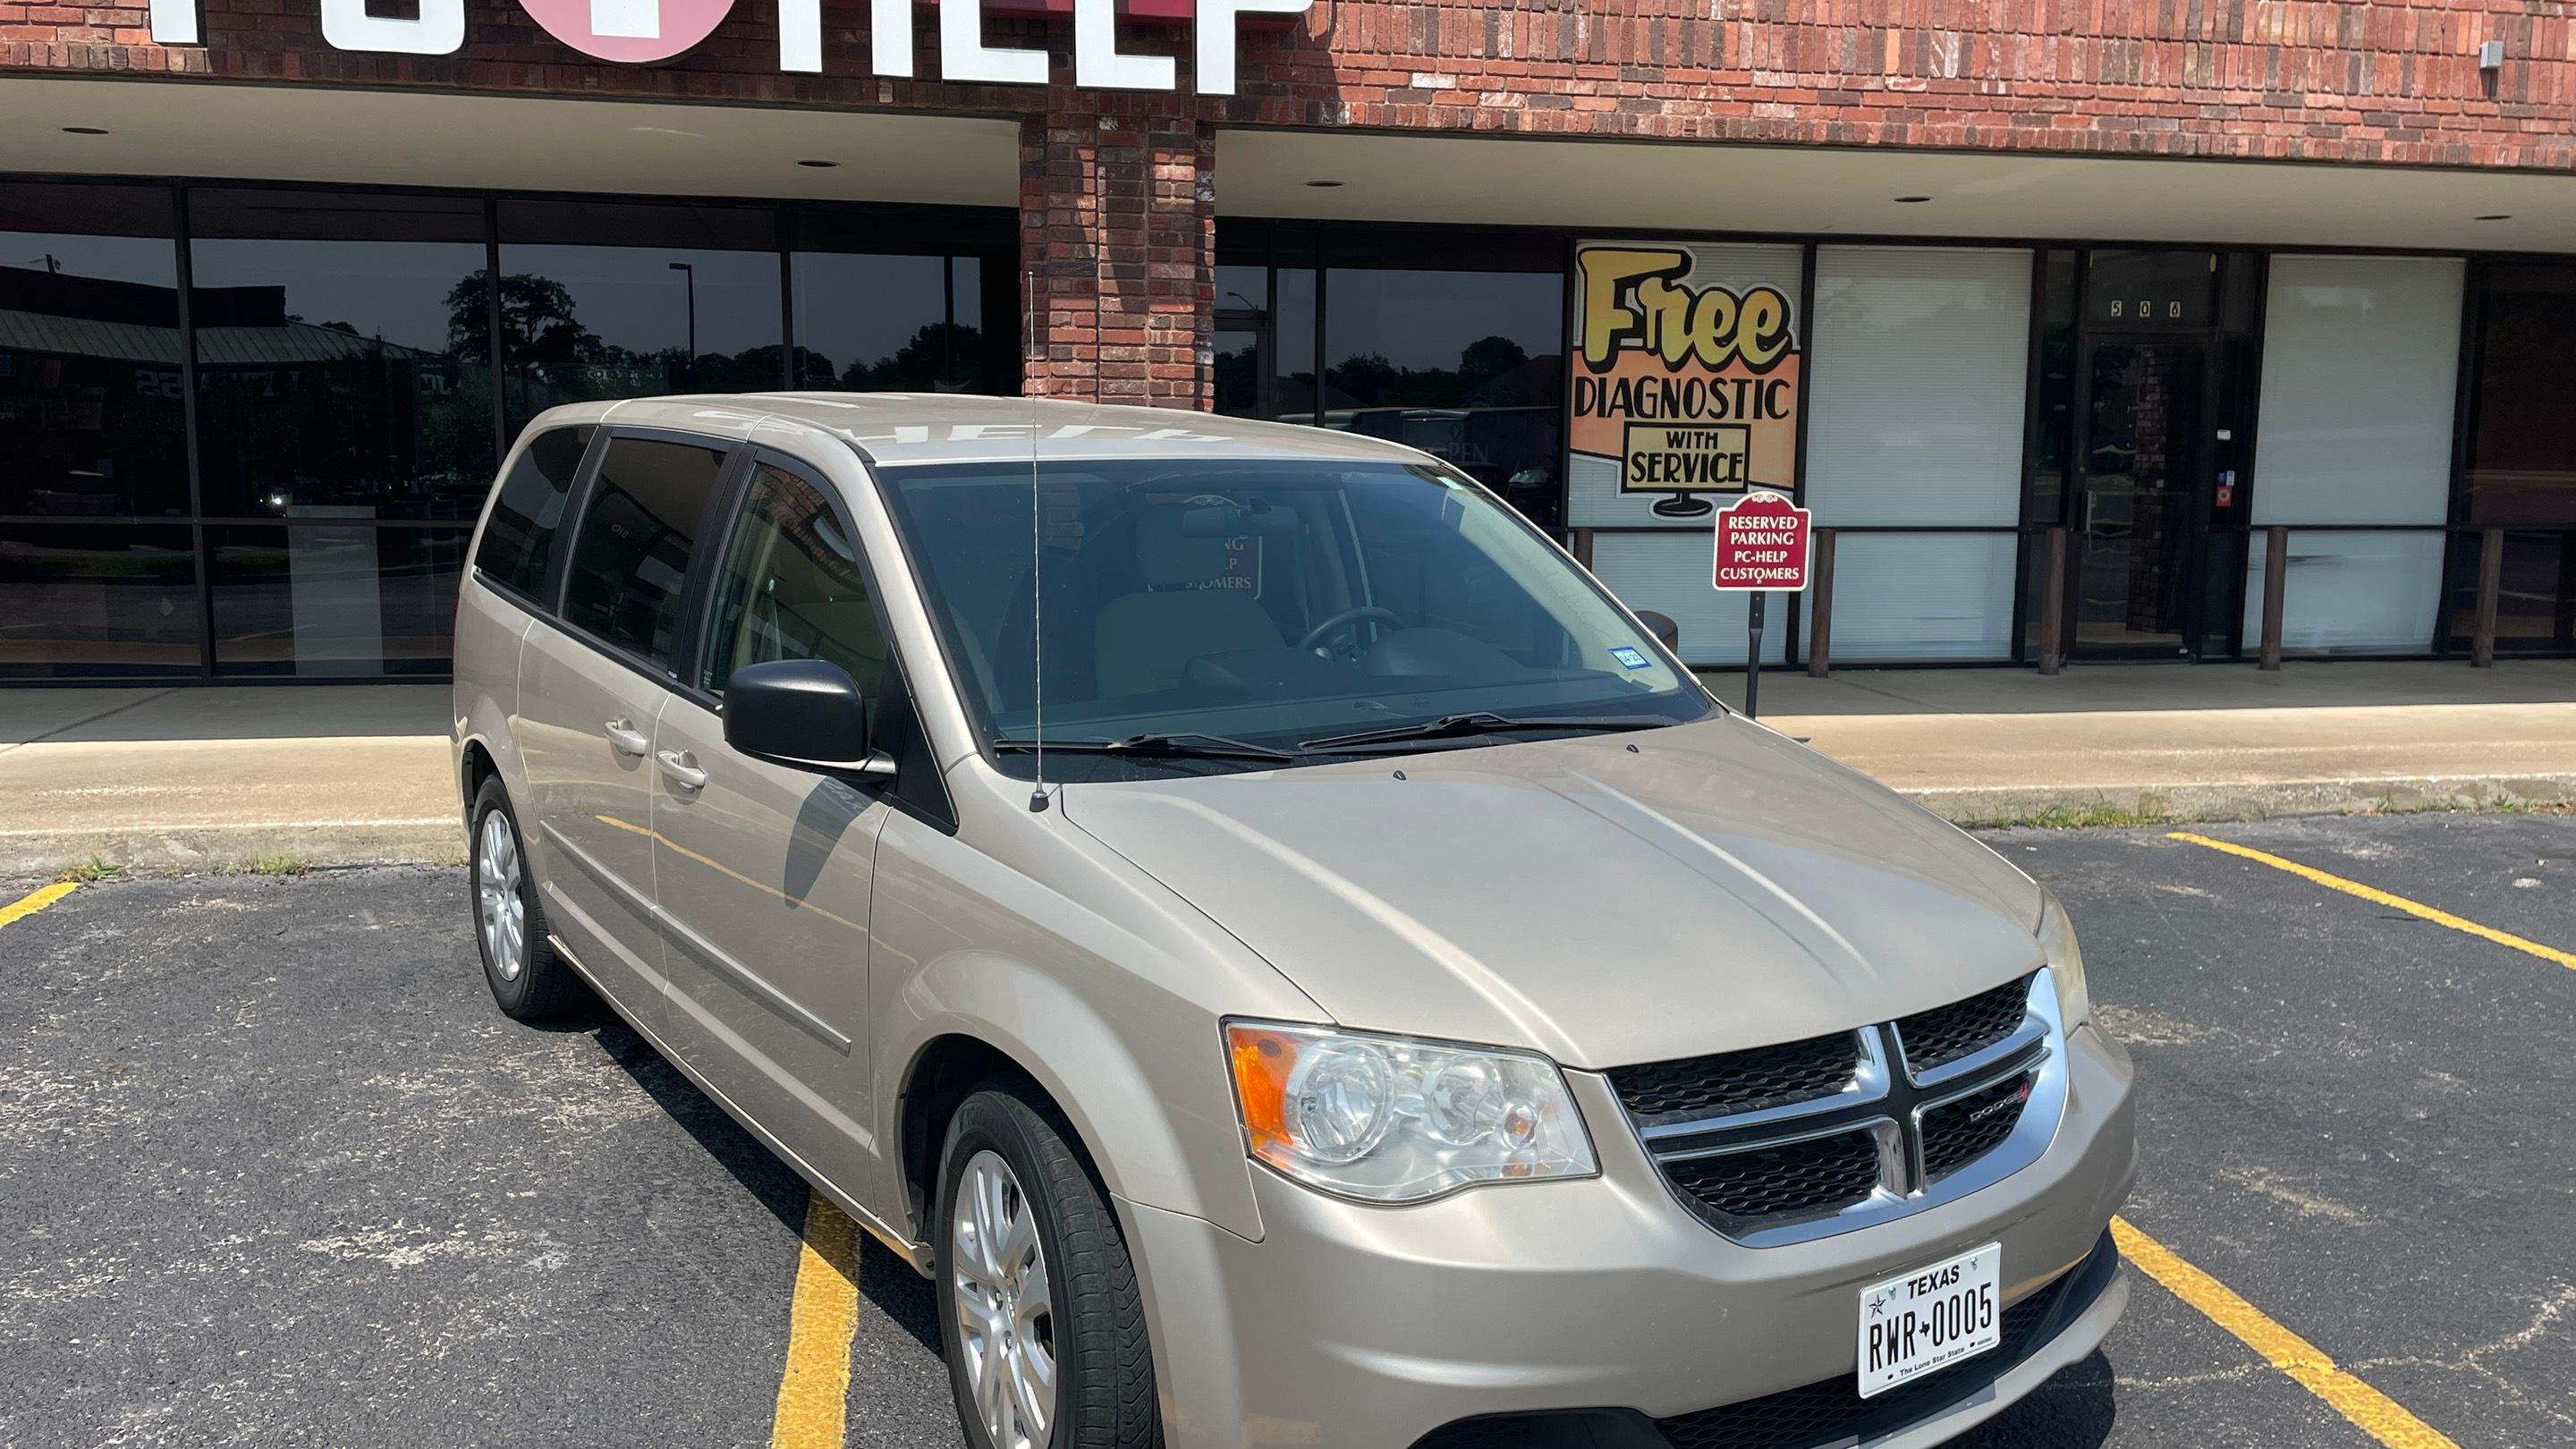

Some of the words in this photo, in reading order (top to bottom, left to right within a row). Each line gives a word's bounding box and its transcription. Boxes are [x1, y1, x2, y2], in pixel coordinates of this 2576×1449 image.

[1578, 247, 1792, 375] Free
[1573, 376, 1791, 419] DIAGNOSTIC
[1665, 430, 1718, 450] WITH
[1631, 452, 1743, 483] SERVICE
[1728, 516, 1799, 530] RESERVED
[1730, 531, 1794, 545] PARKING
[1734, 550, 1788, 563] PC-HELP
[1720, 567, 1800, 580] CUSTOMERS
[1907, 1265, 1960, 1300] TEXAS
[1900, 1367, 1912, 1377] The
[1914, 1359, 1931, 1371] Lone
[1932, 1353, 1946, 1364] Star
[1947, 1346, 1965, 1358] State
